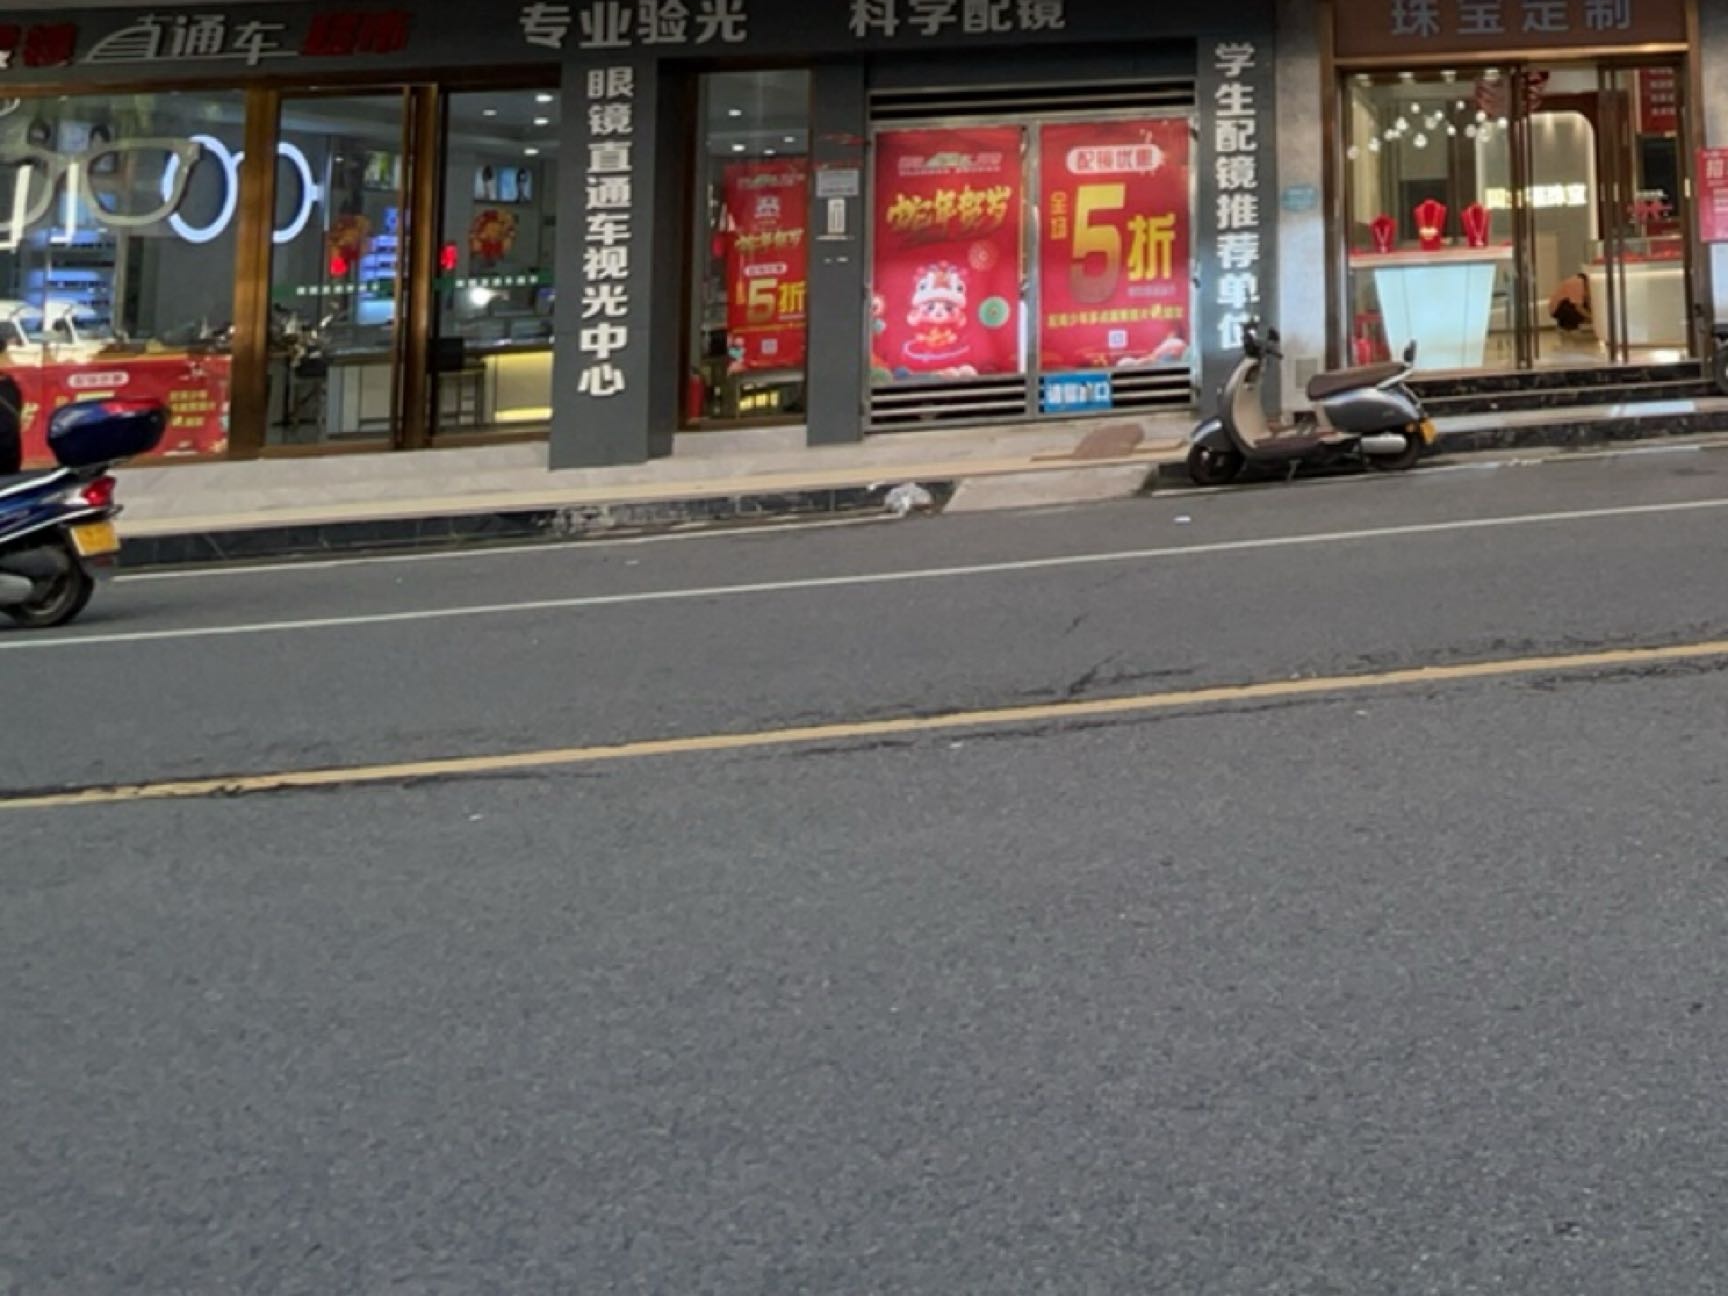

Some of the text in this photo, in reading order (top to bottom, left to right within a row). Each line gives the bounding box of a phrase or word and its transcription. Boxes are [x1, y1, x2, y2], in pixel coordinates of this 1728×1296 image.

[577, 65, 635, 398] 眼镜直通车视光中心
[1069, 181, 1177, 304] 5折
[1214, 41, 1260, 349] 学生配镜推荐单位
